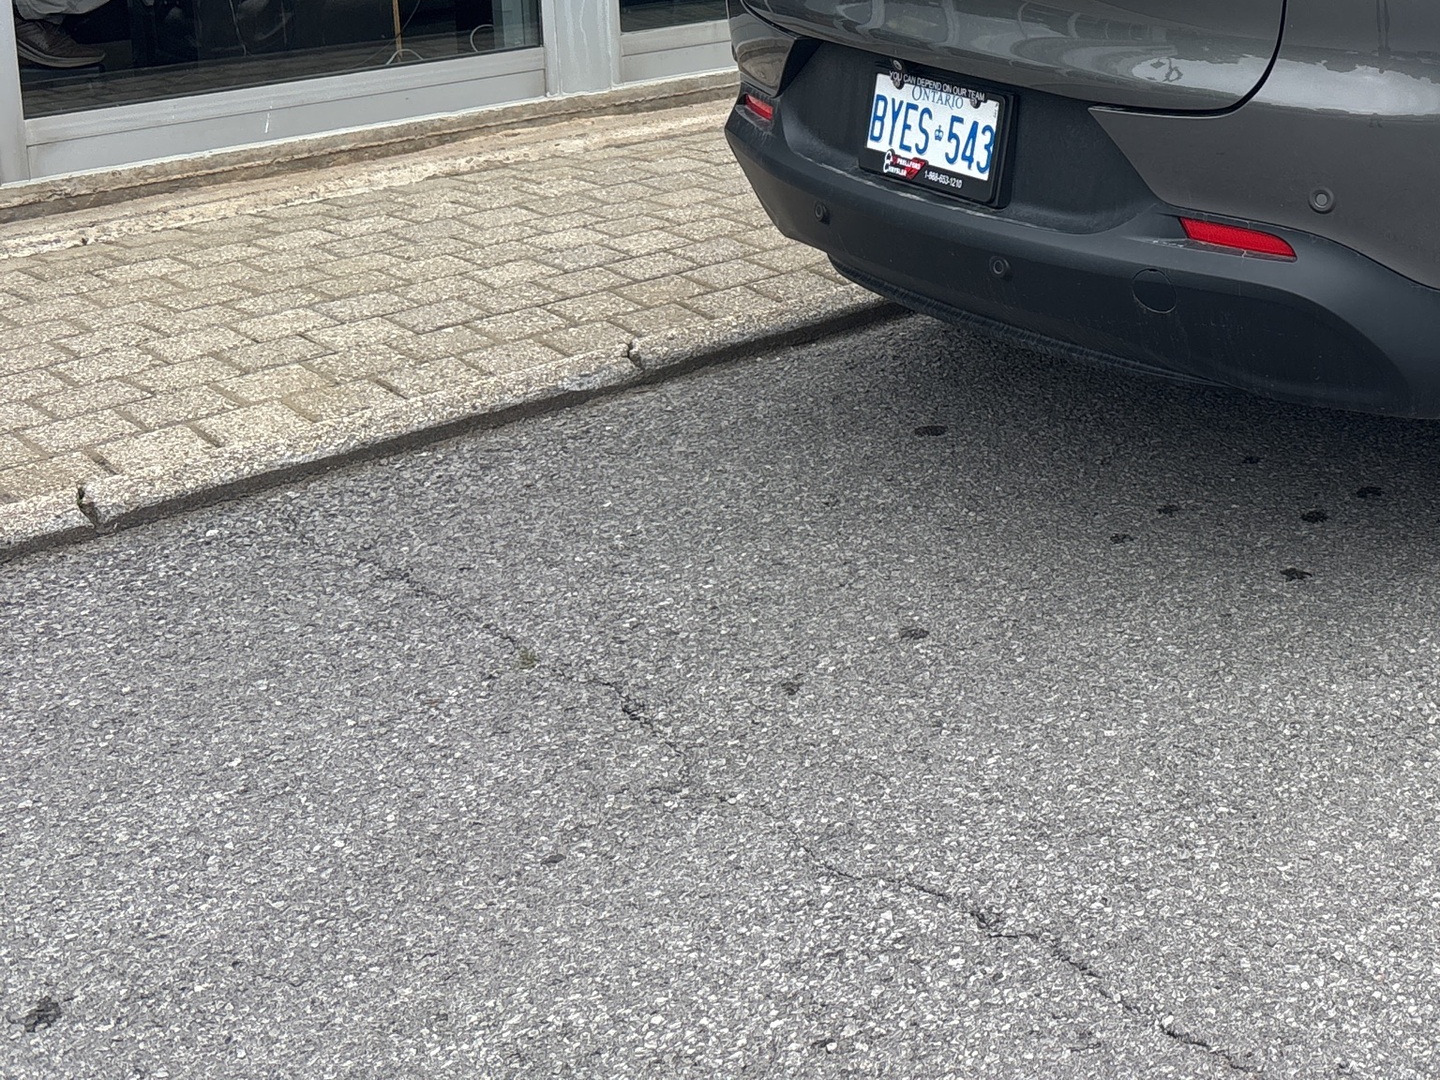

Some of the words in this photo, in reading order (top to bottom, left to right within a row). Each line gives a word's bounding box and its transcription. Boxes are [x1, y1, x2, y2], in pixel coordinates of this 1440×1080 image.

[889, 70, 903, 81] YOU
[903, 74, 917, 85] CAN
[917, 77, 942, 91] DEPEND
[942, 83, 952, 94] ON
[952, 86, 967, 97] OUR
[968, 89, 985, 101] TEAM
[869, 94, 933, 155] BYES
[944, 114, 995, 174] 543
